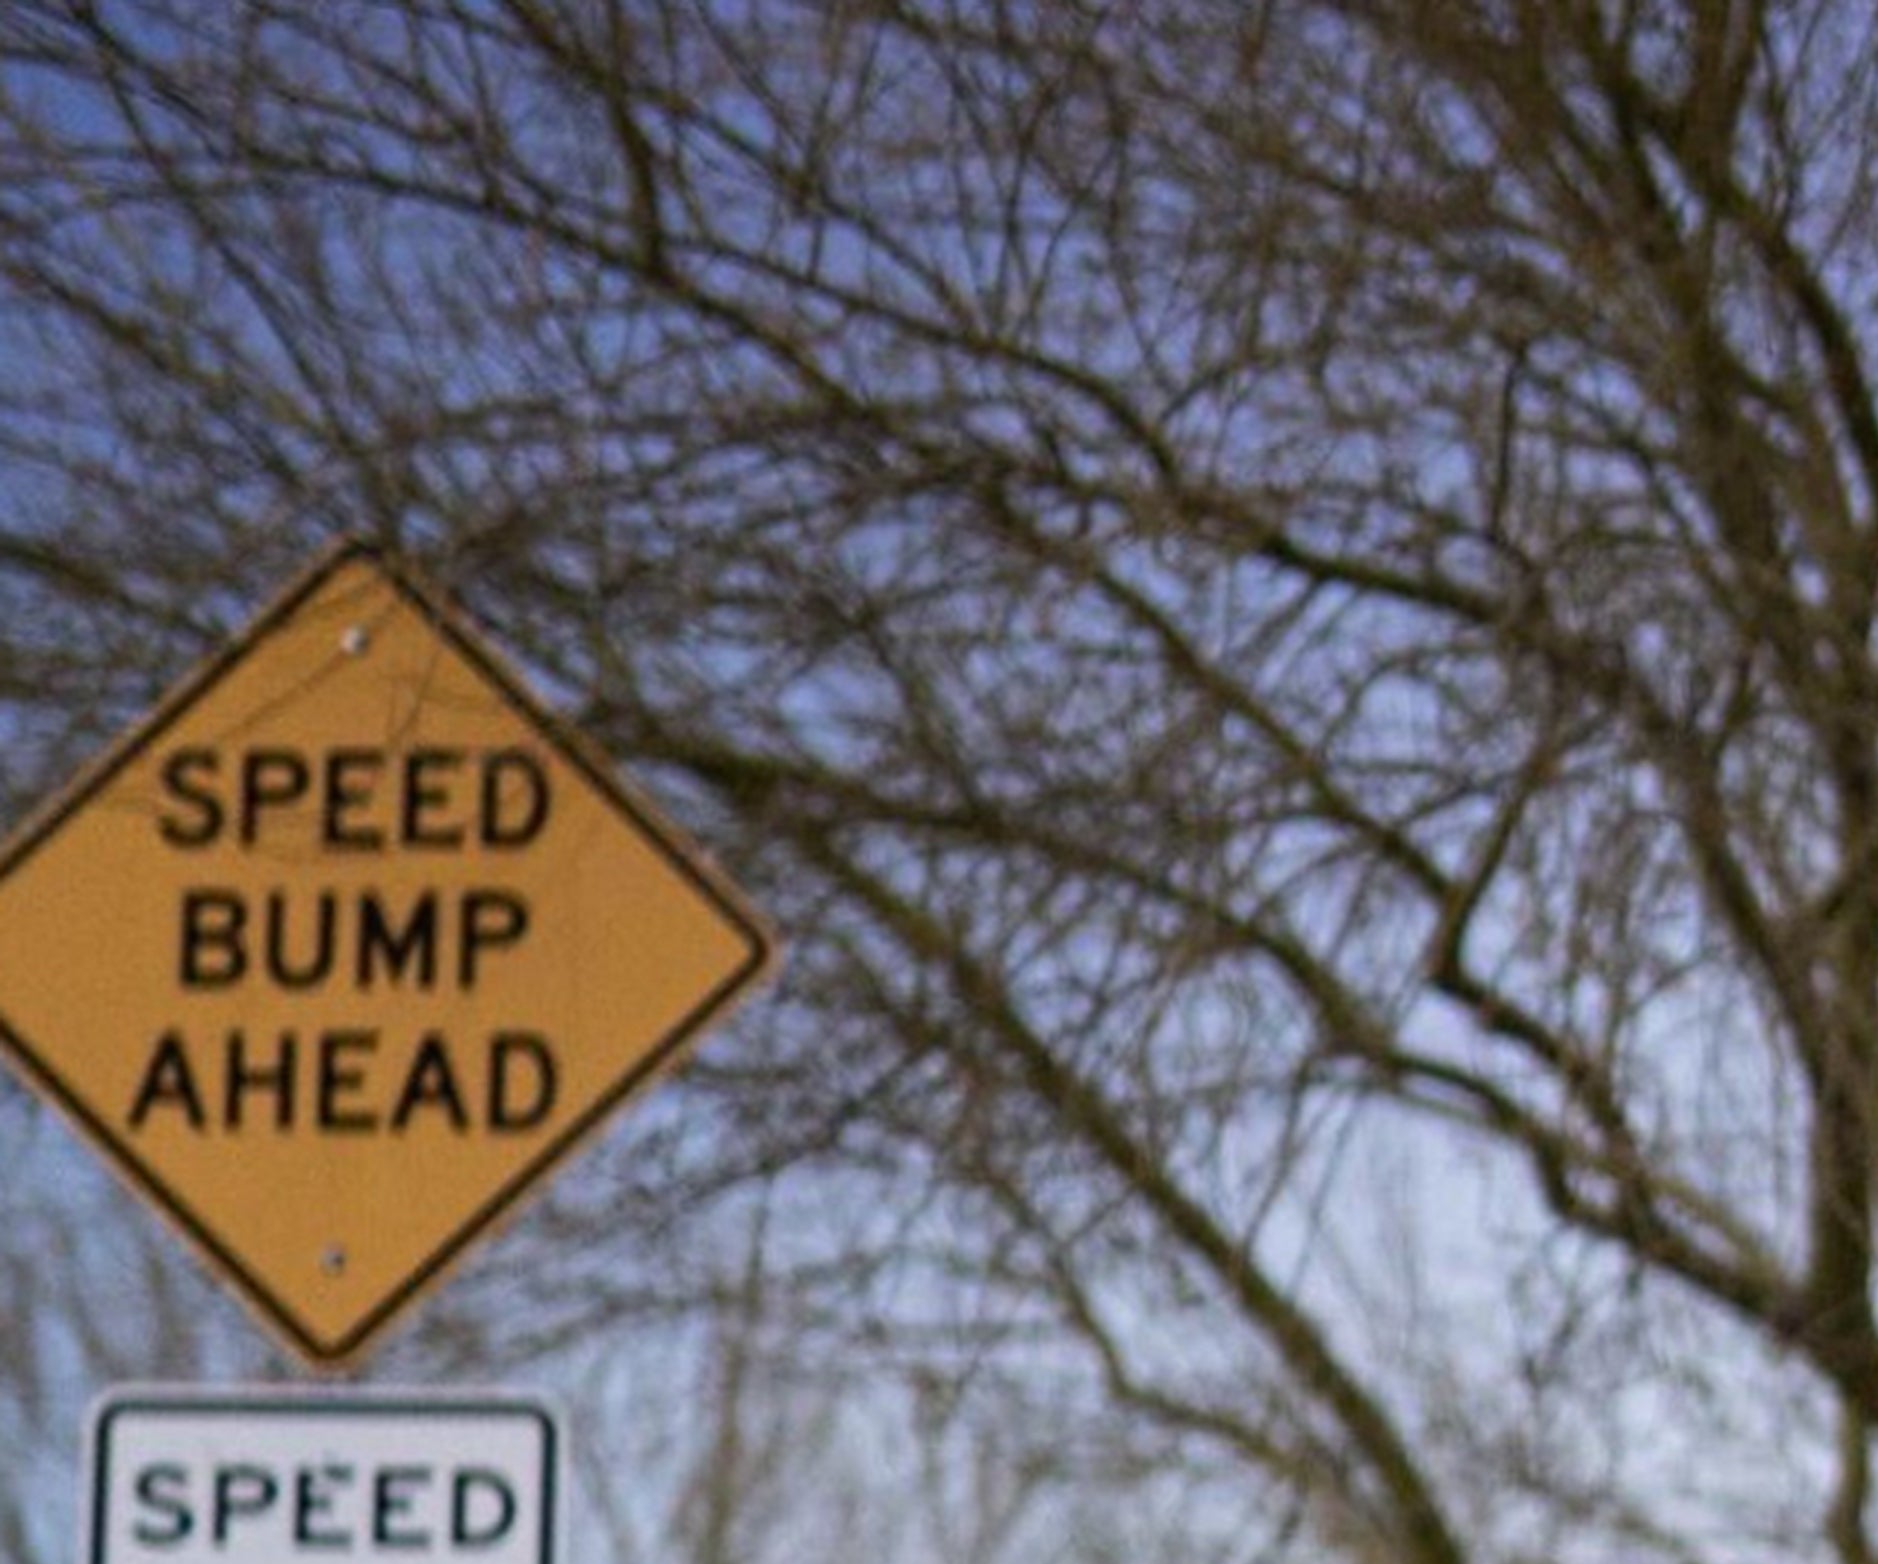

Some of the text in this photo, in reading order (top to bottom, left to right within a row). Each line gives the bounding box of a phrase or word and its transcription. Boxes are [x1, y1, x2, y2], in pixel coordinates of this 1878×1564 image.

[156, 746, 551, 853] SPEED
[179, 887, 530, 991] BUMP
[127, 1030, 561, 1137] AHEAD
[133, 1464, 518, 1550] SPEED
